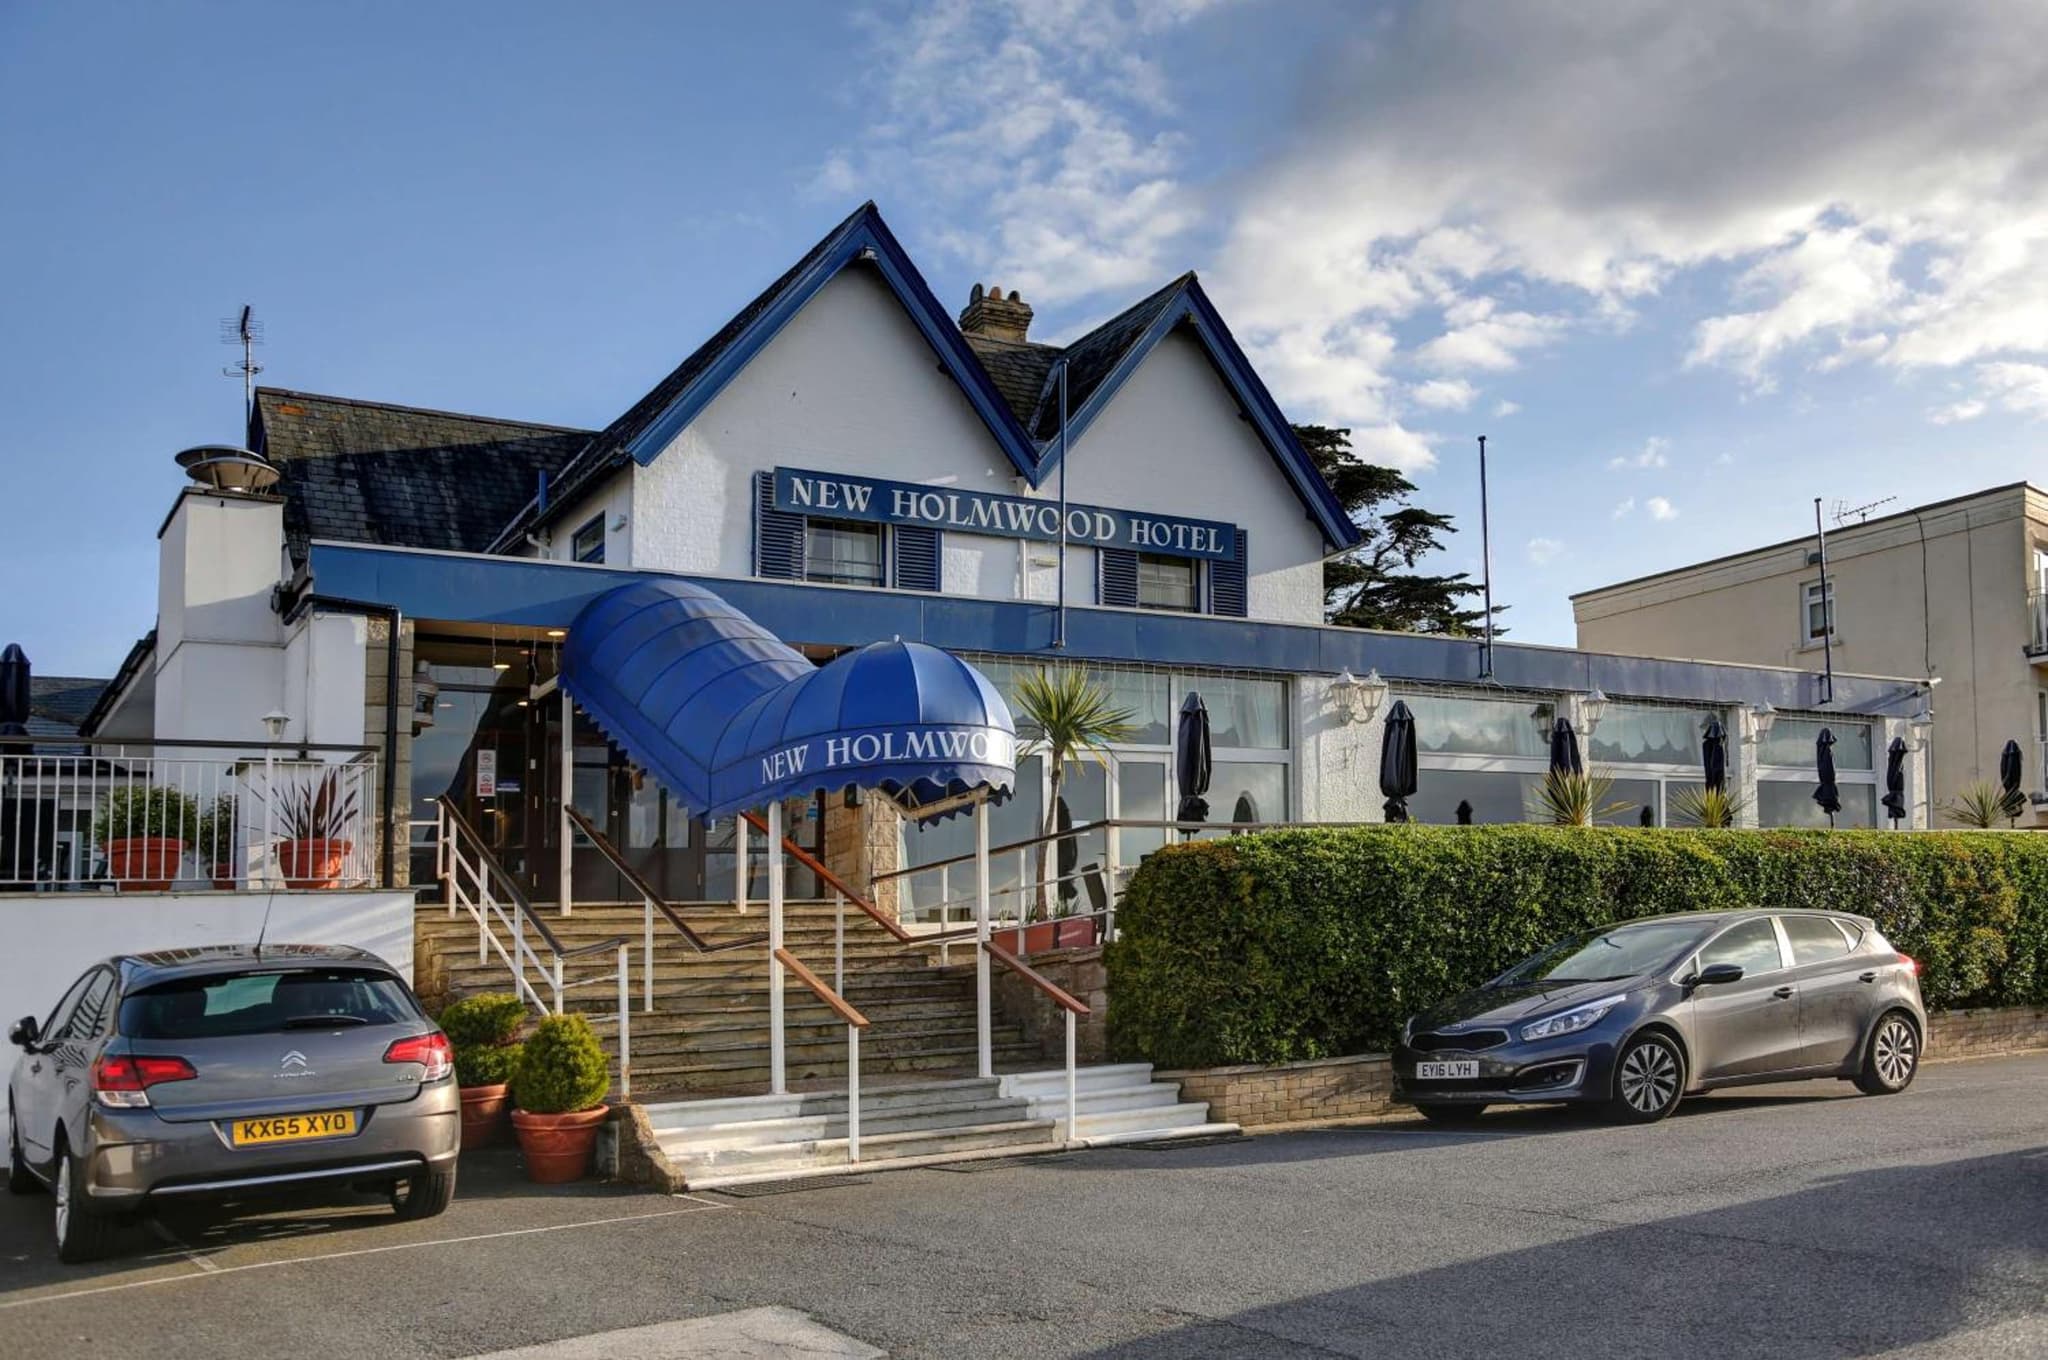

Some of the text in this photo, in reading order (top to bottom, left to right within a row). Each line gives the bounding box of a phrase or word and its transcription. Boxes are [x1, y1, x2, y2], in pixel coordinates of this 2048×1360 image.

[789, 477, 1225, 554] NEW HOLMWOOD HOTEL
[762, 731, 1015, 784] NEW HOLMWOD
[1422, 1063, 1471, 1077] EY16 LYH
[243, 1114, 346, 1139] KX65 XYO
